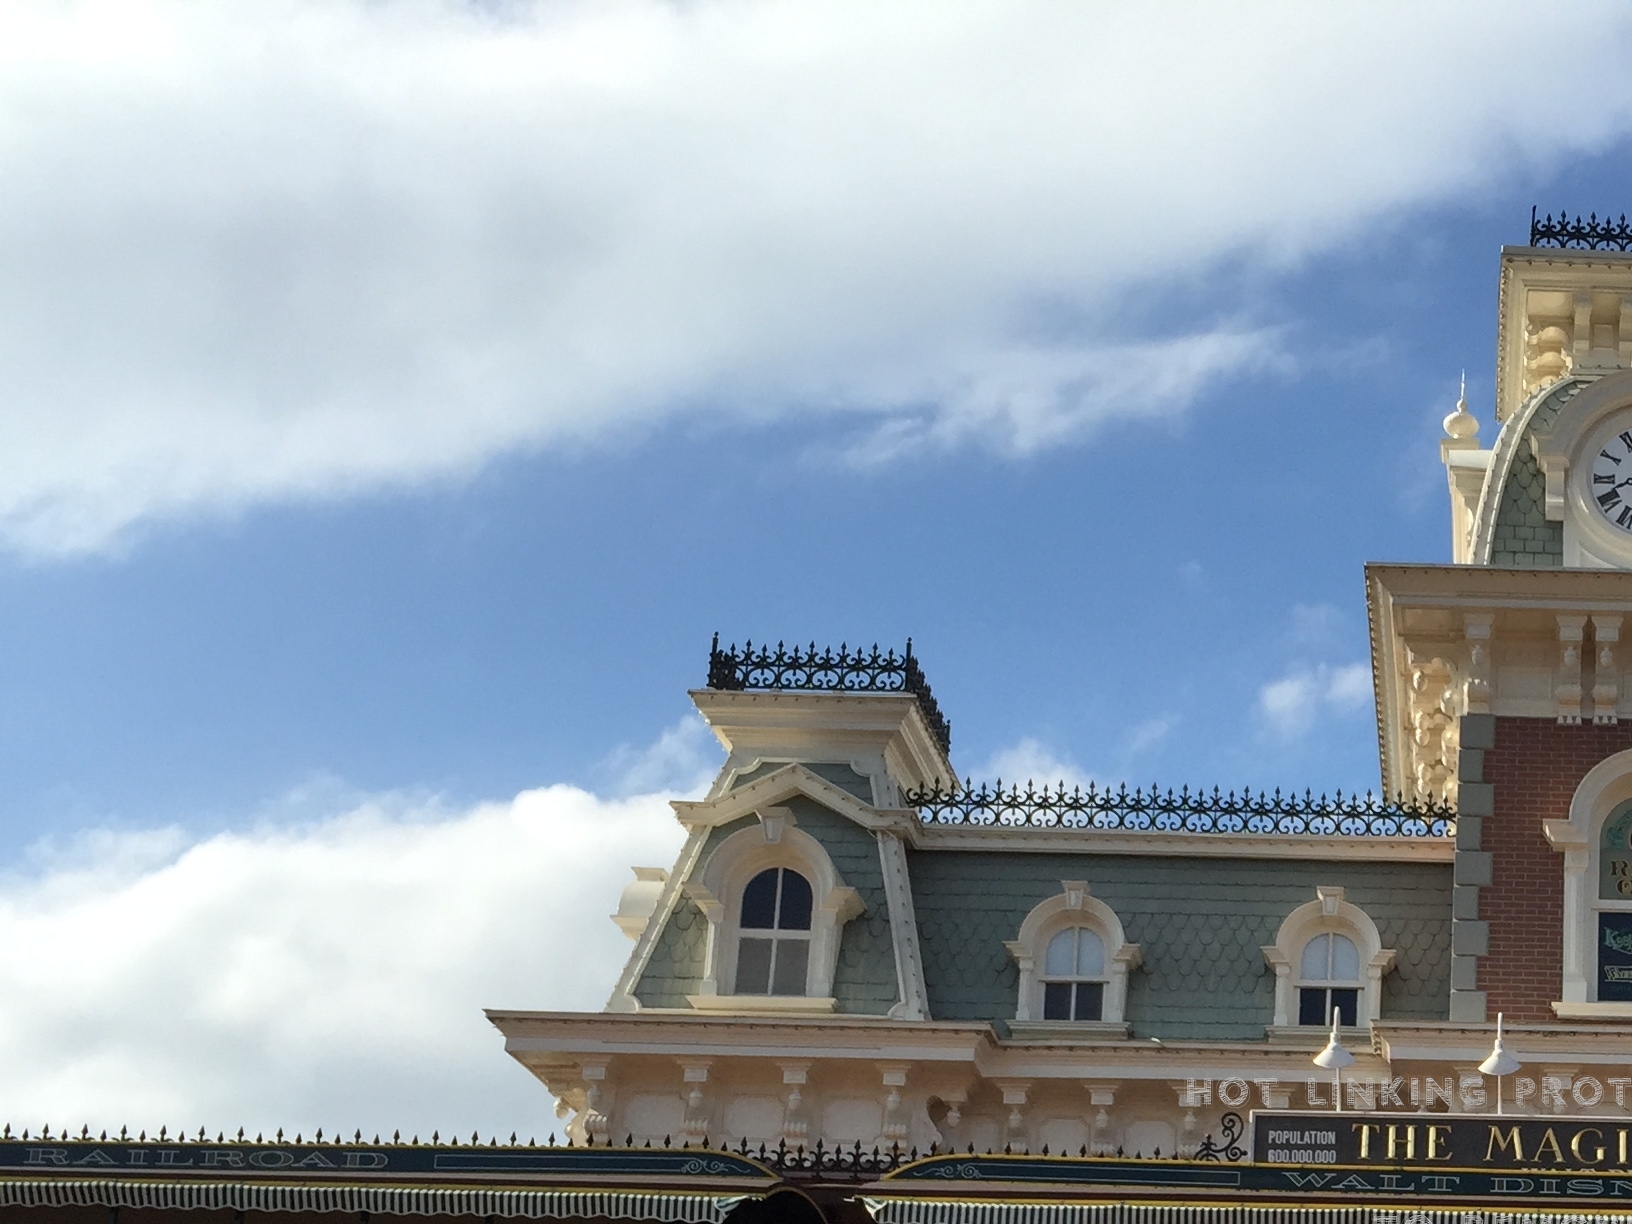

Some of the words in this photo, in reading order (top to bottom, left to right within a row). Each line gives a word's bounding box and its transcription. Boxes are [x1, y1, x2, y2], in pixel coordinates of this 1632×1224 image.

[1268, 1130, 1336, 1145] POPULATION
[1351, 1123, 1454, 1161] THE
[22, 1147, 389, 1168] RAILROAD
[1282, 1171, 1460, 1192] WALT
